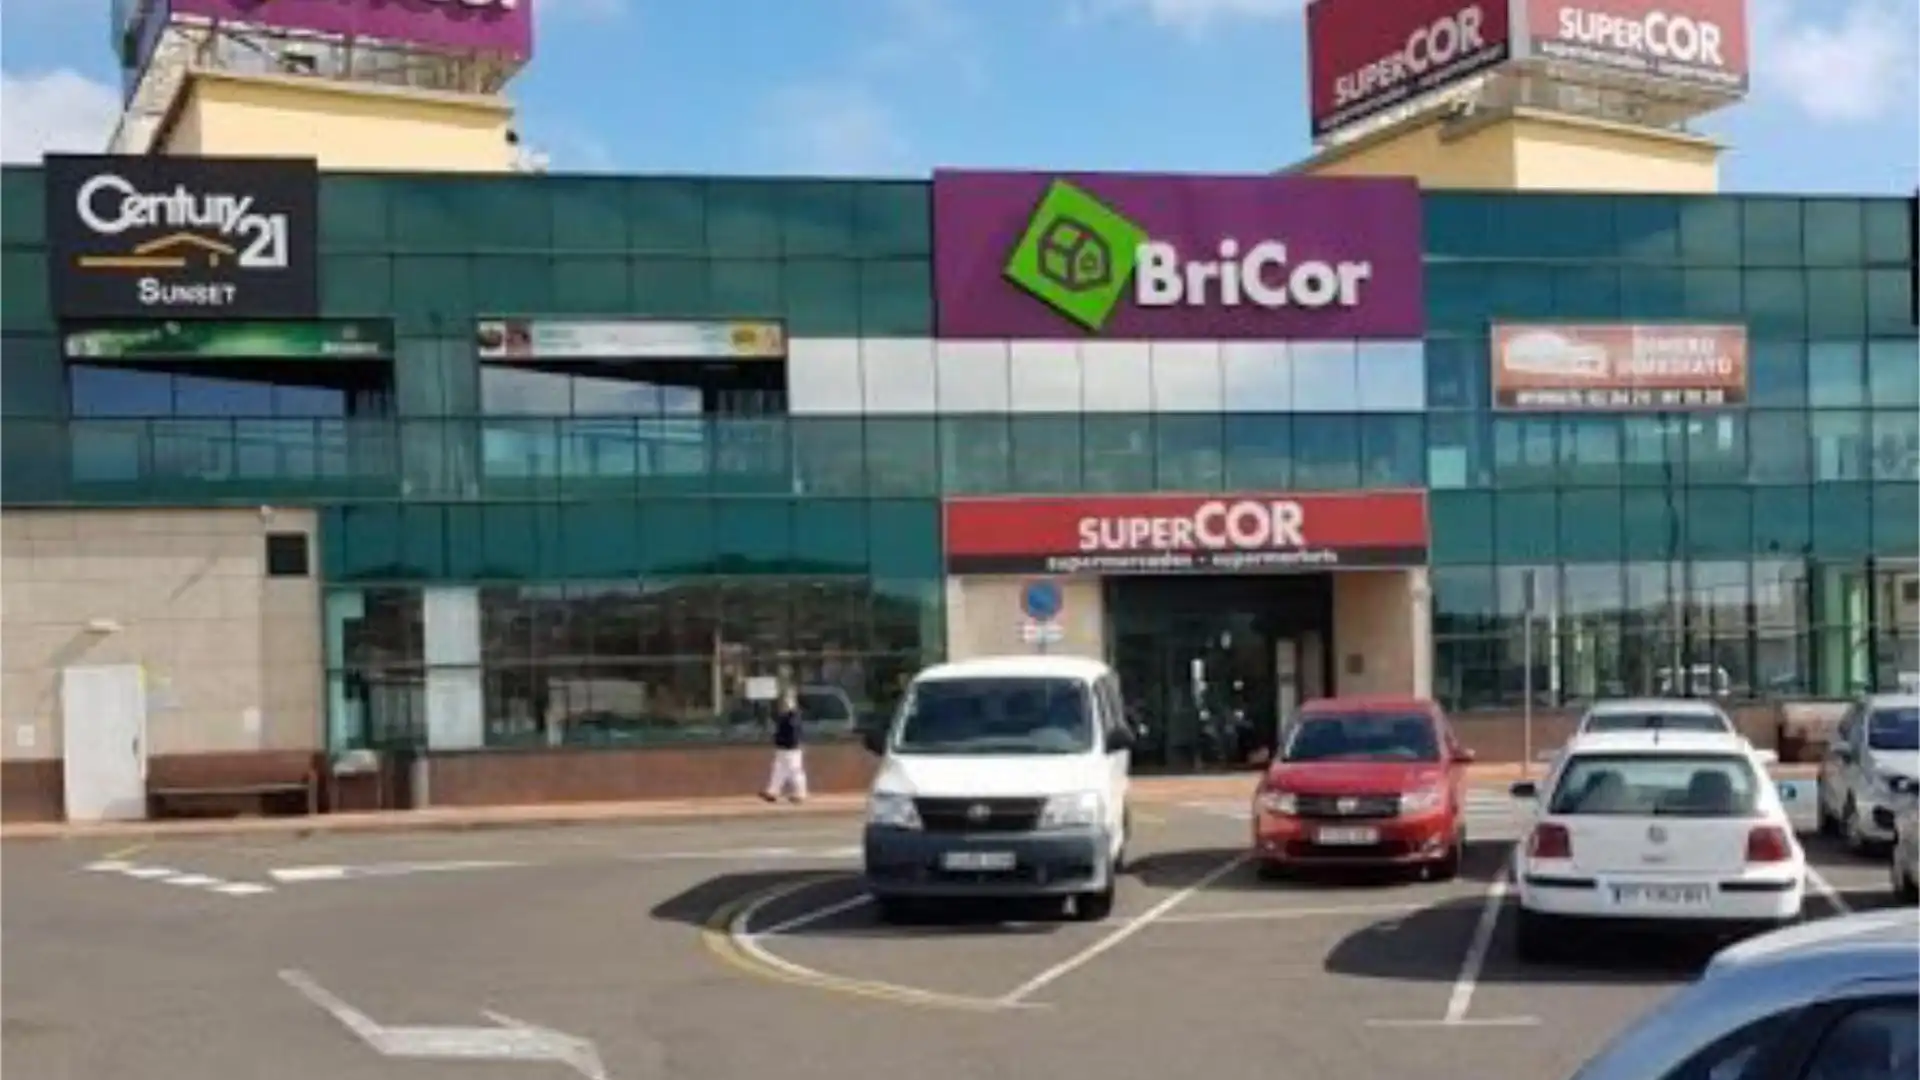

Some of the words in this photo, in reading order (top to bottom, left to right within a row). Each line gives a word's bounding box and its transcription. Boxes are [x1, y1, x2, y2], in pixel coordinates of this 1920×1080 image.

[1335, 5, 1485, 105] SUPERCOR
[1558, 6, 1724, 66] SUPERCOR
[76, 174, 253, 234] Century
[236, 213, 289, 267] 21
[1136, 239, 1371, 306] BriCor
[1078, 500, 1305, 550] SUPERCOR
